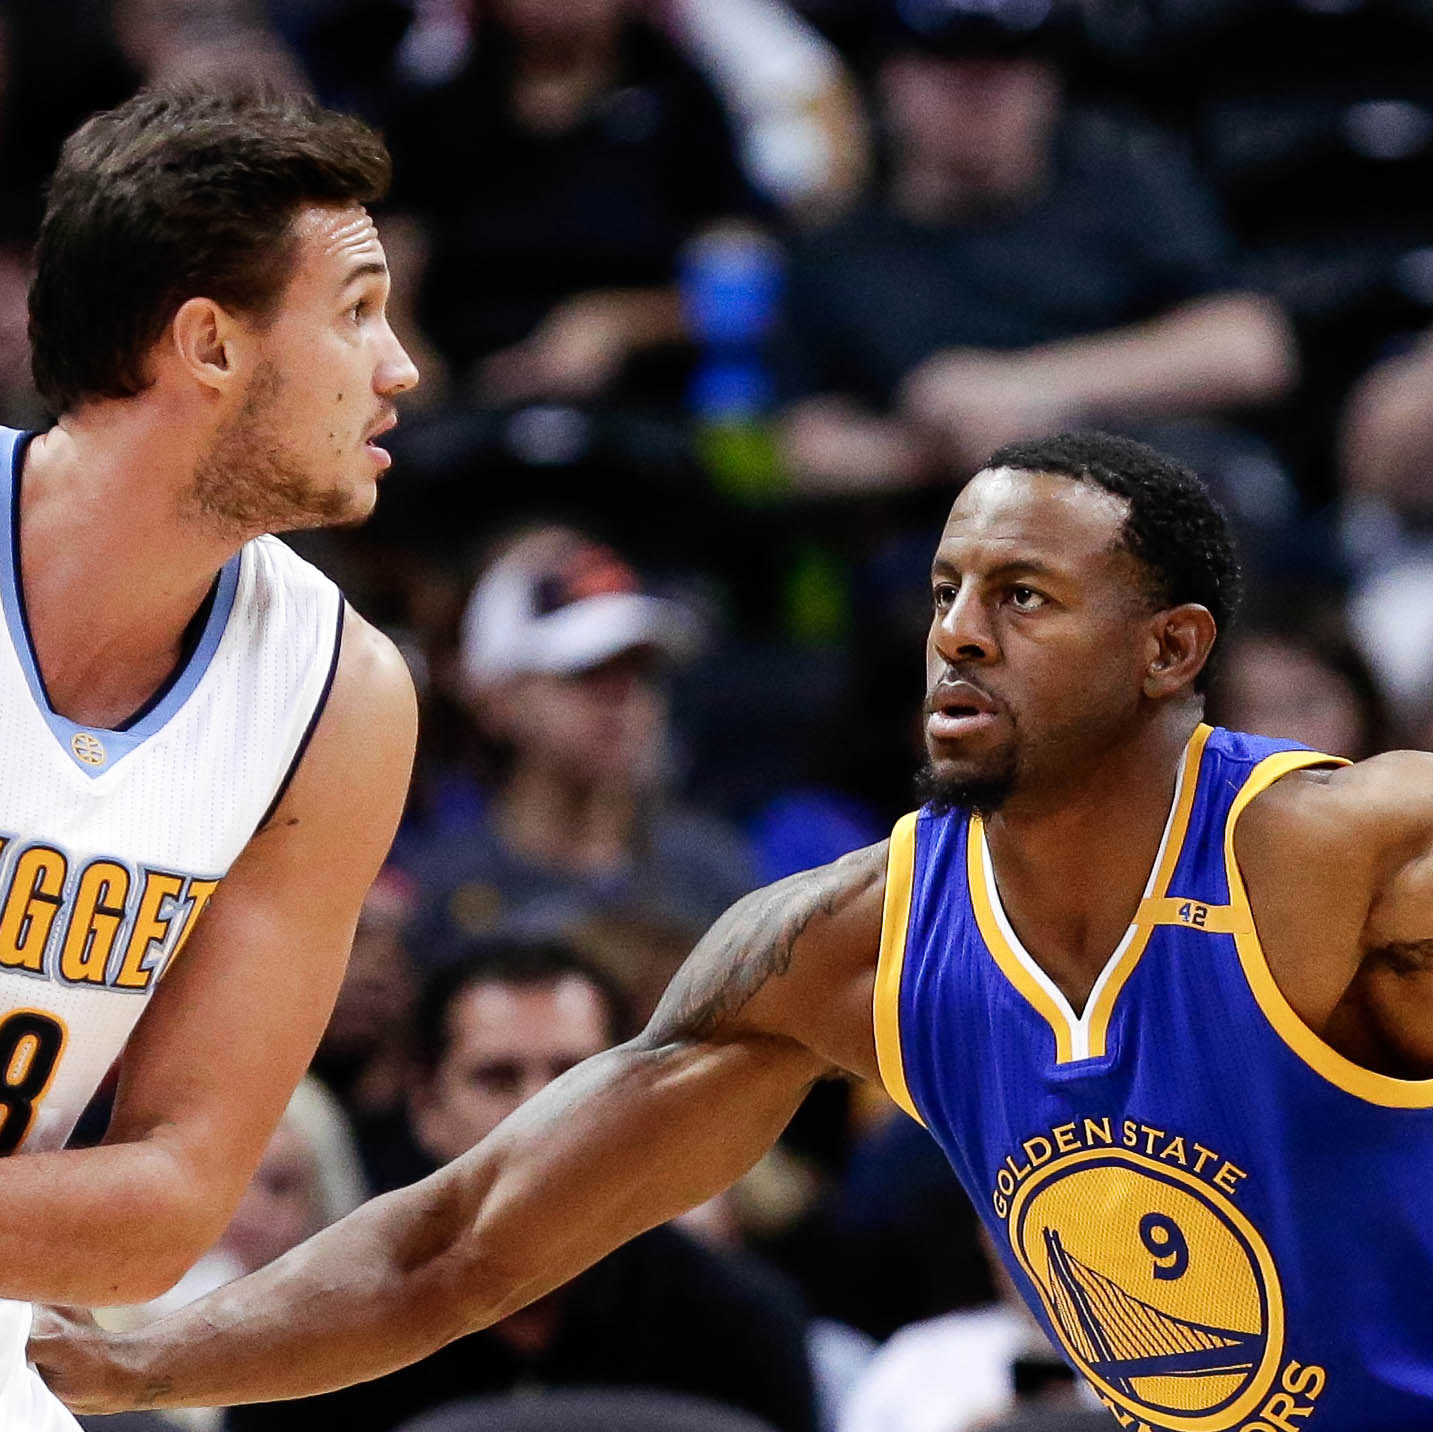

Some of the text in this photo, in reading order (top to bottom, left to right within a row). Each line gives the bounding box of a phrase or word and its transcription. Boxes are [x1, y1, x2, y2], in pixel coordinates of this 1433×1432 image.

[1179, 902, 1208, 927] 42
[993, 1117, 1248, 1219] GOLDEN STATE
[1138, 1211, 1190, 1281] 9
